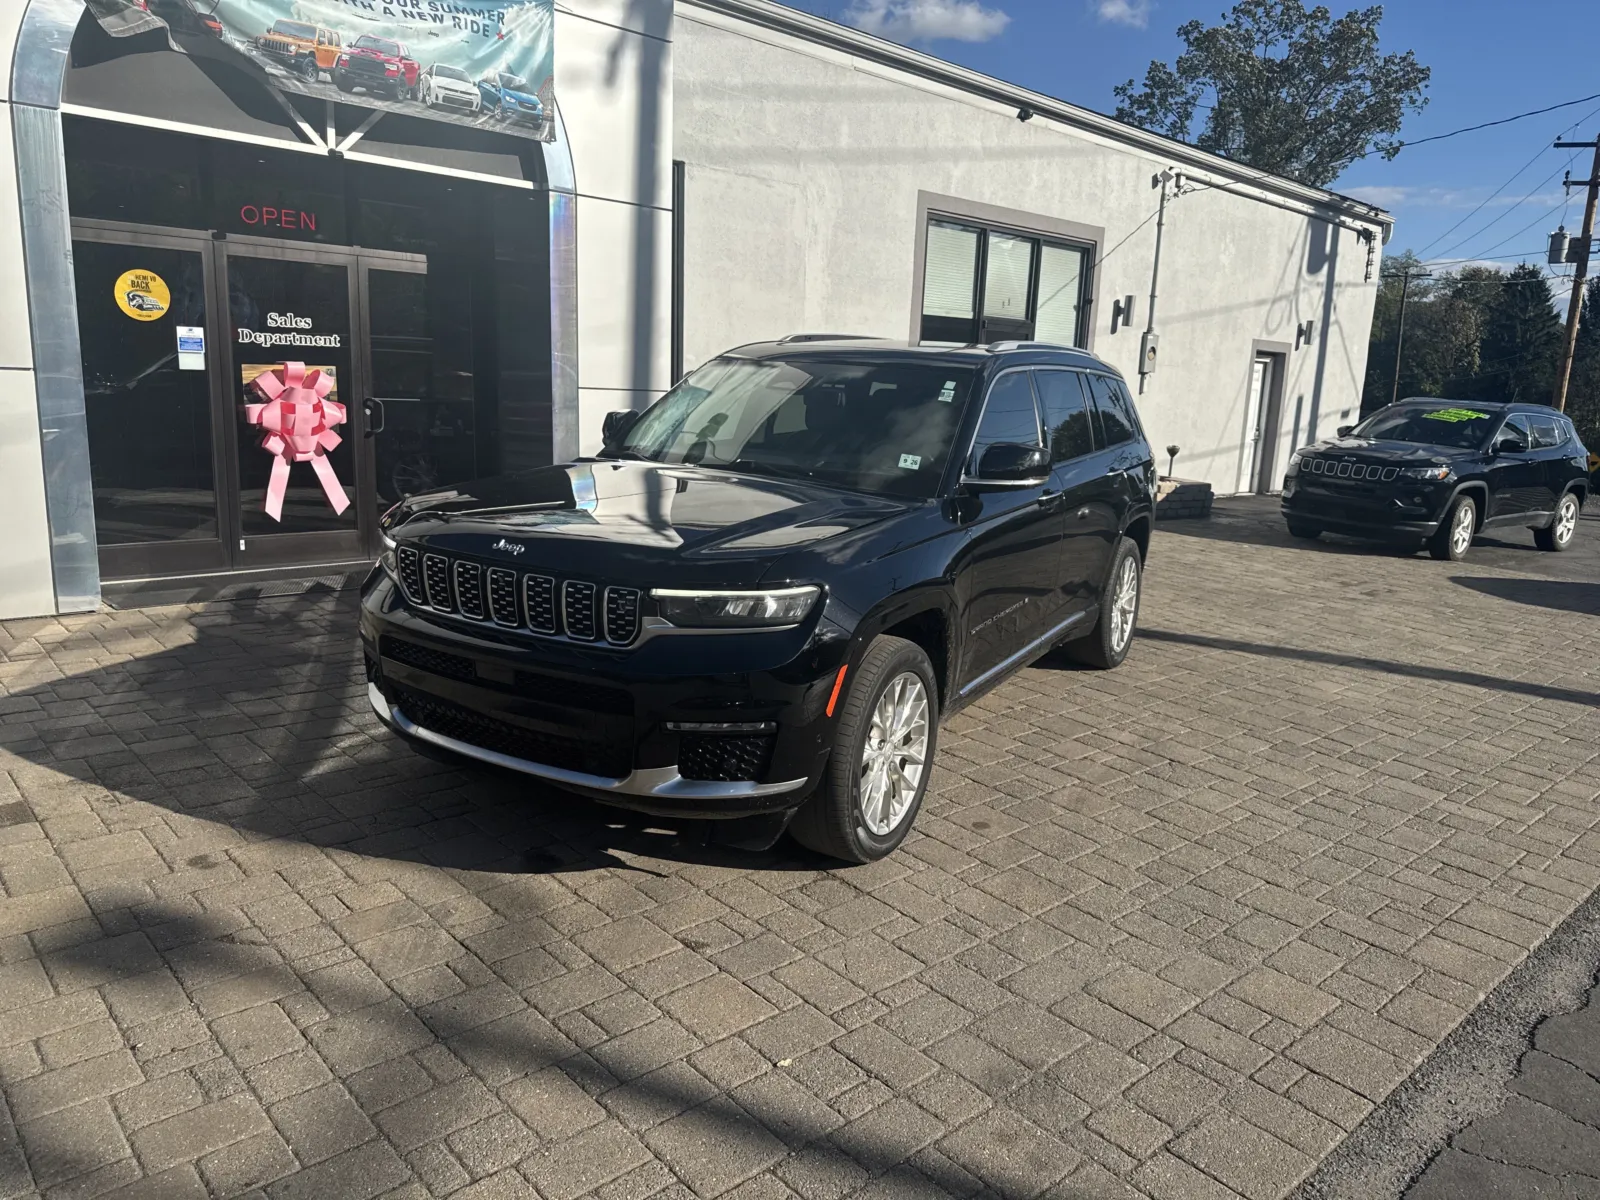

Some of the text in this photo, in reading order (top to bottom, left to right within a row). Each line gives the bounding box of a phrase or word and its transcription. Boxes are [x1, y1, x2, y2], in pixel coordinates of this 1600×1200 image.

[383, 6, 396, 17] A
[403, 9, 445, 25] NEW
[452, 15, 490, 38] RIDE
[427, 1, 506, 26] SUMMER
[241, 205, 316, 231] OPEN
[131, 279, 151, 290] BACK
[267, 312, 312, 330] Sales
[238, 328, 341, 348] Department
[491, 538, 526, 556] Jeep
